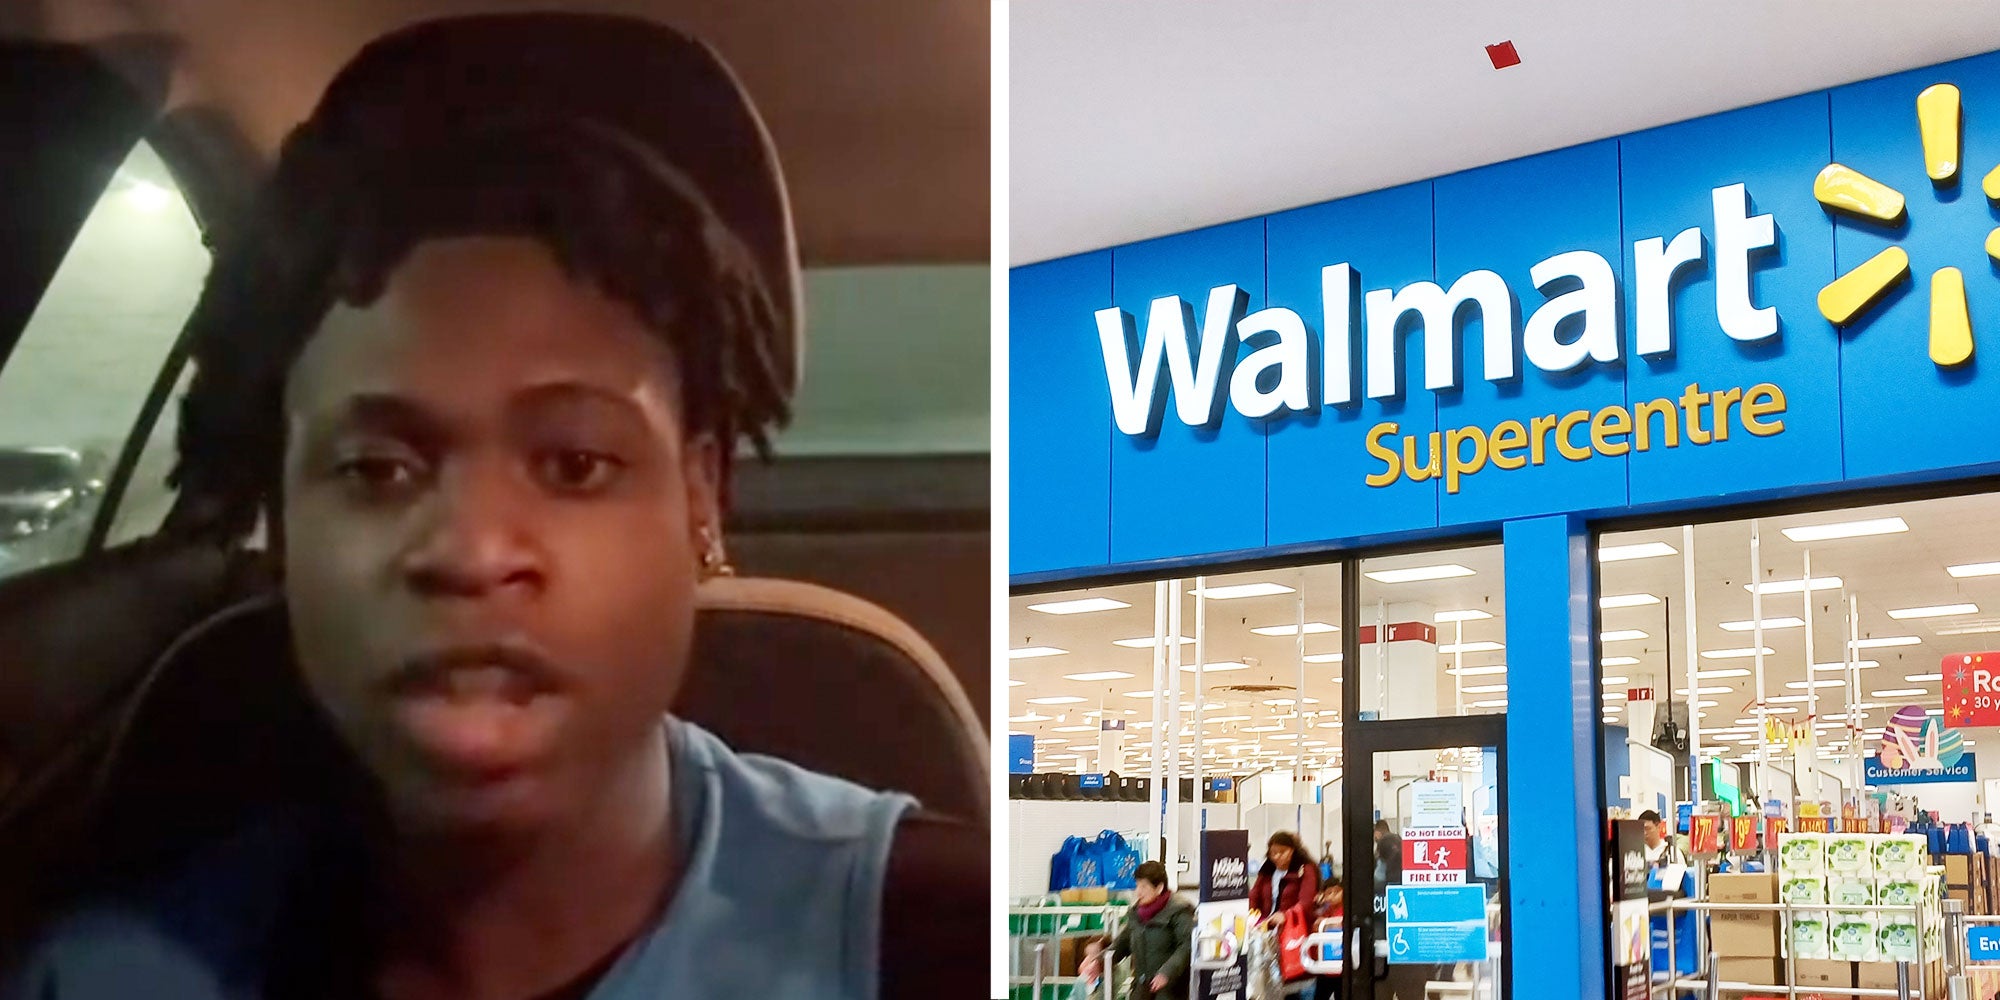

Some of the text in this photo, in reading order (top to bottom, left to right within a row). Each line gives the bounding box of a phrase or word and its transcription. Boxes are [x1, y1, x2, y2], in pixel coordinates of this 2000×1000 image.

[1095, 183, 1779, 436] Walmart
[1365, 384, 1787, 494] Supercentre
[1974, 696, 1991, 709] 30
[1867, 766, 1969, 778] Customer Service
[1438, 829, 1462, 837] BLOCK
[1409, 873, 1459, 882] FIRE EXIT
[1979, 936, 2000, 951] En
